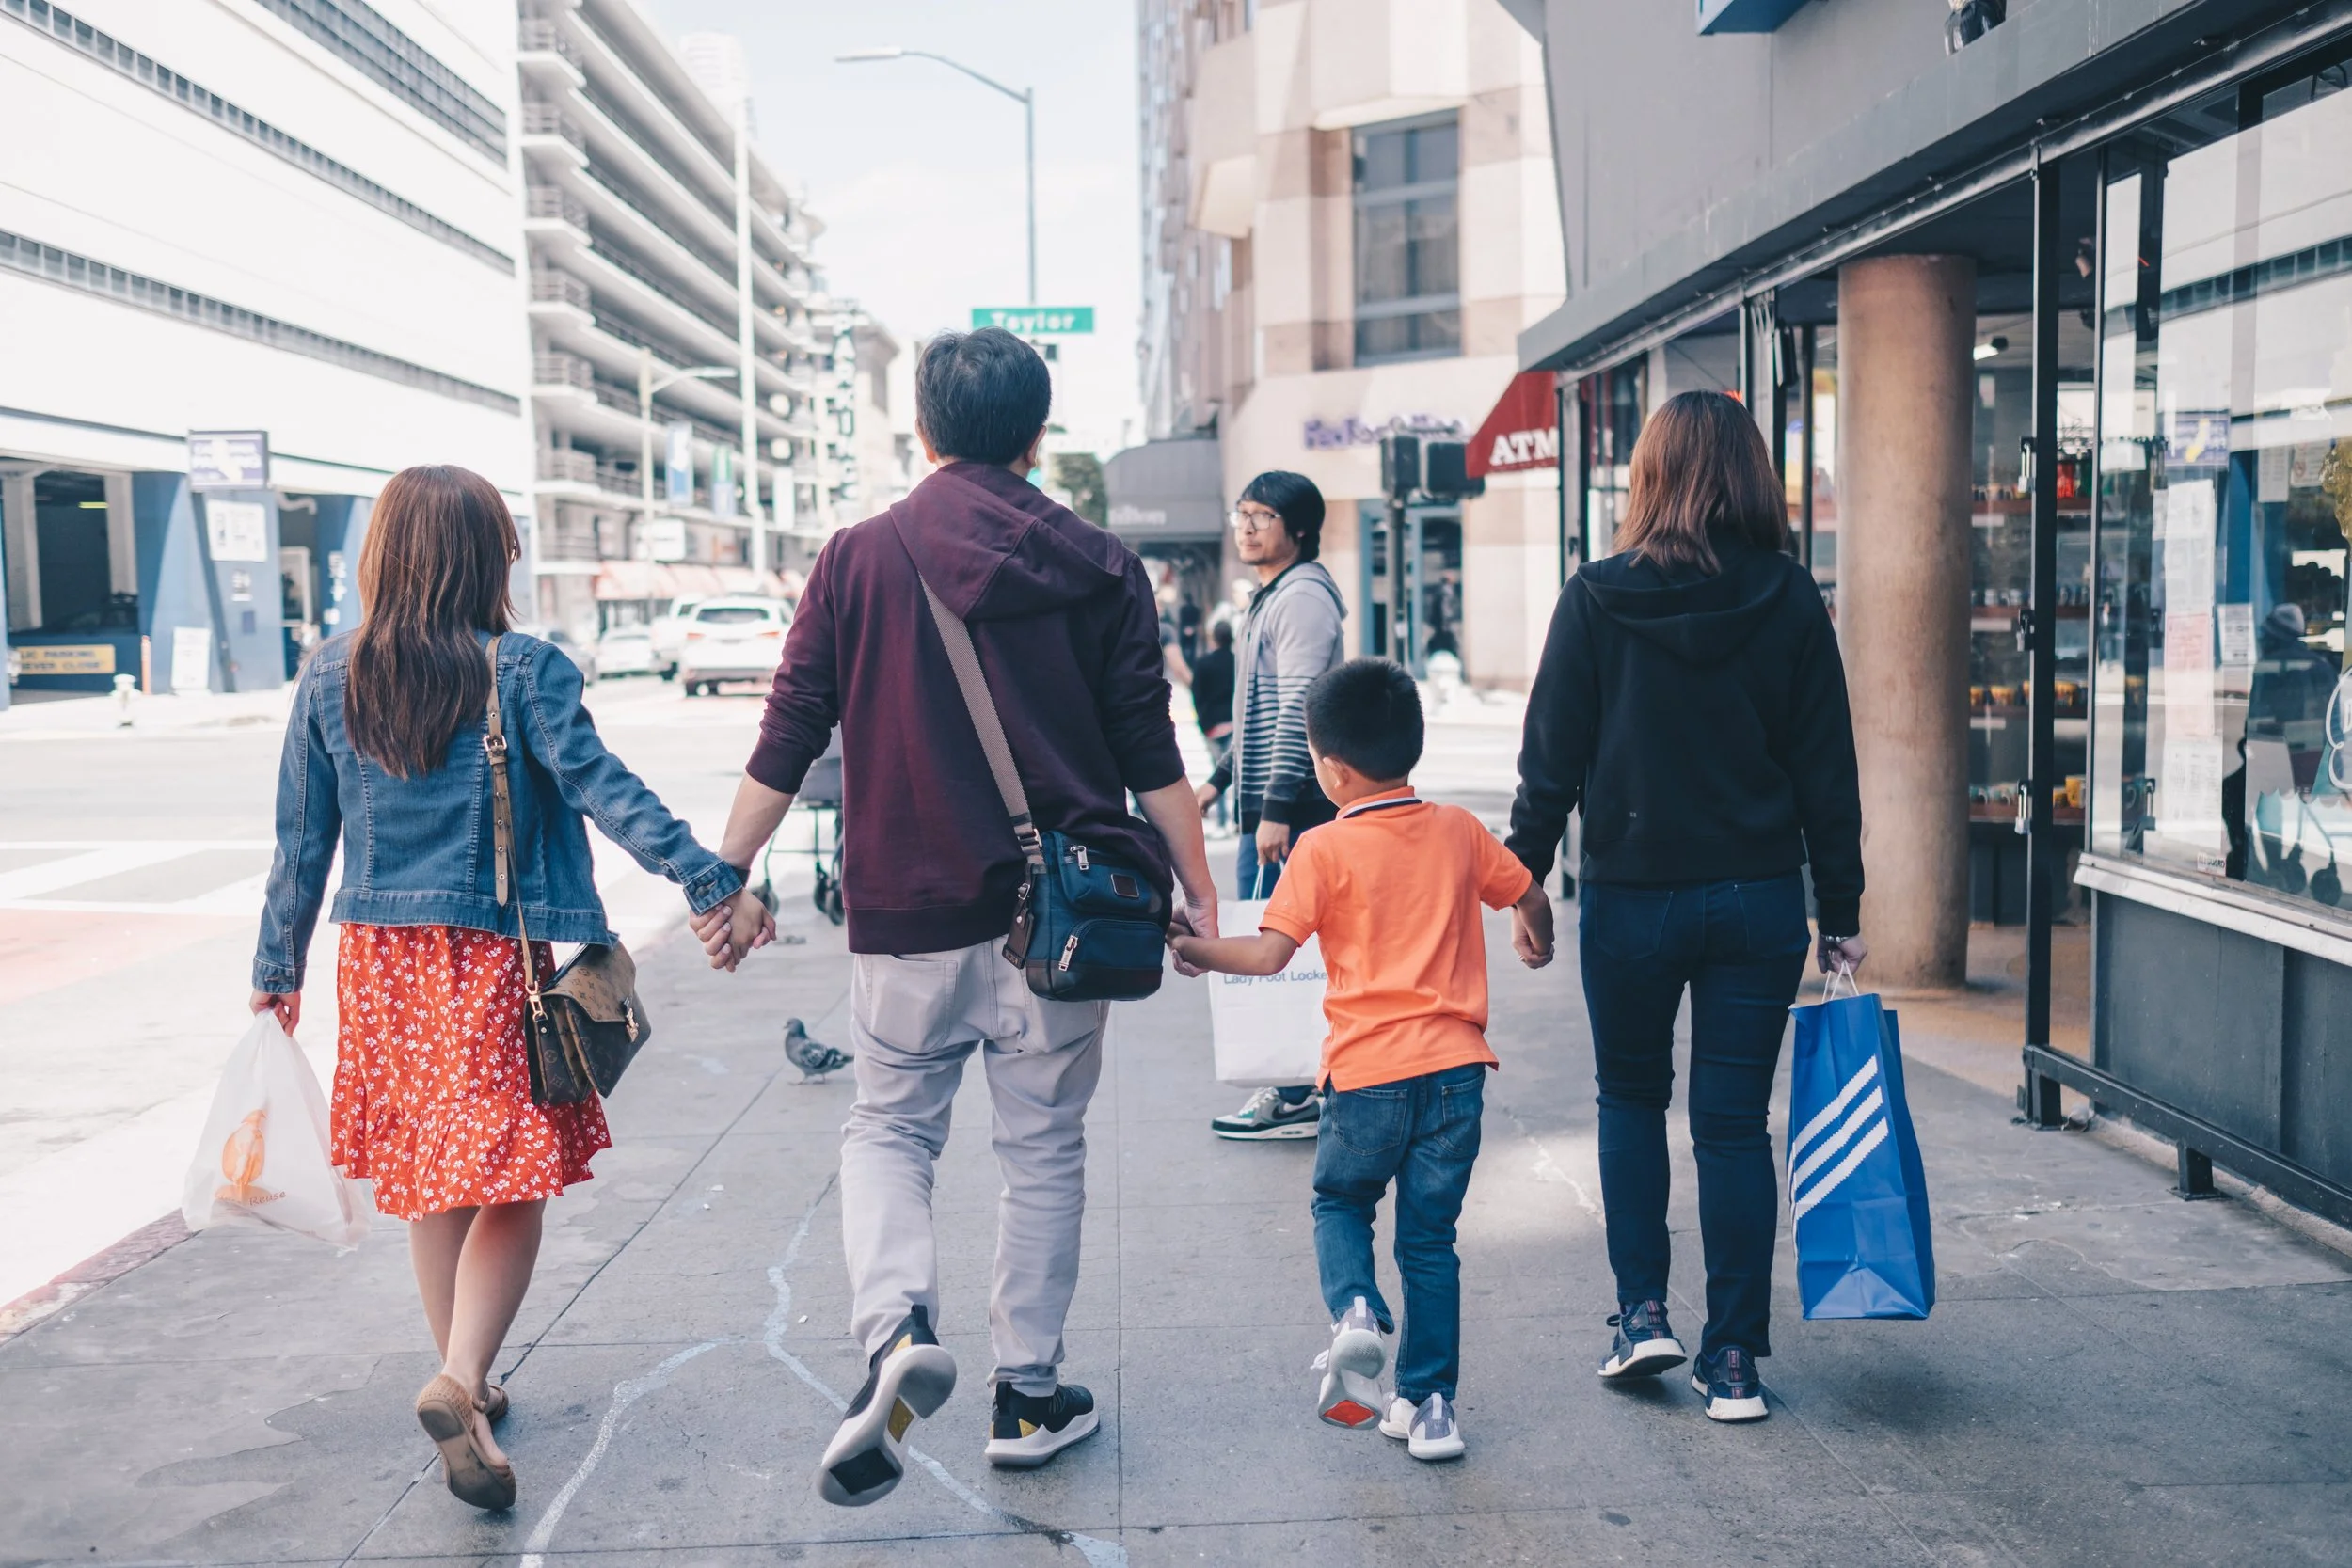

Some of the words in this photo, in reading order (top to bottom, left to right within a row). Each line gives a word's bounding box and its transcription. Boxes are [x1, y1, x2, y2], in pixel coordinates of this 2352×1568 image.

[1488, 426, 1560, 467] ATM
[1290, 969, 1327, 982] Locke
[249, 1191, 286, 1206] Reuse
